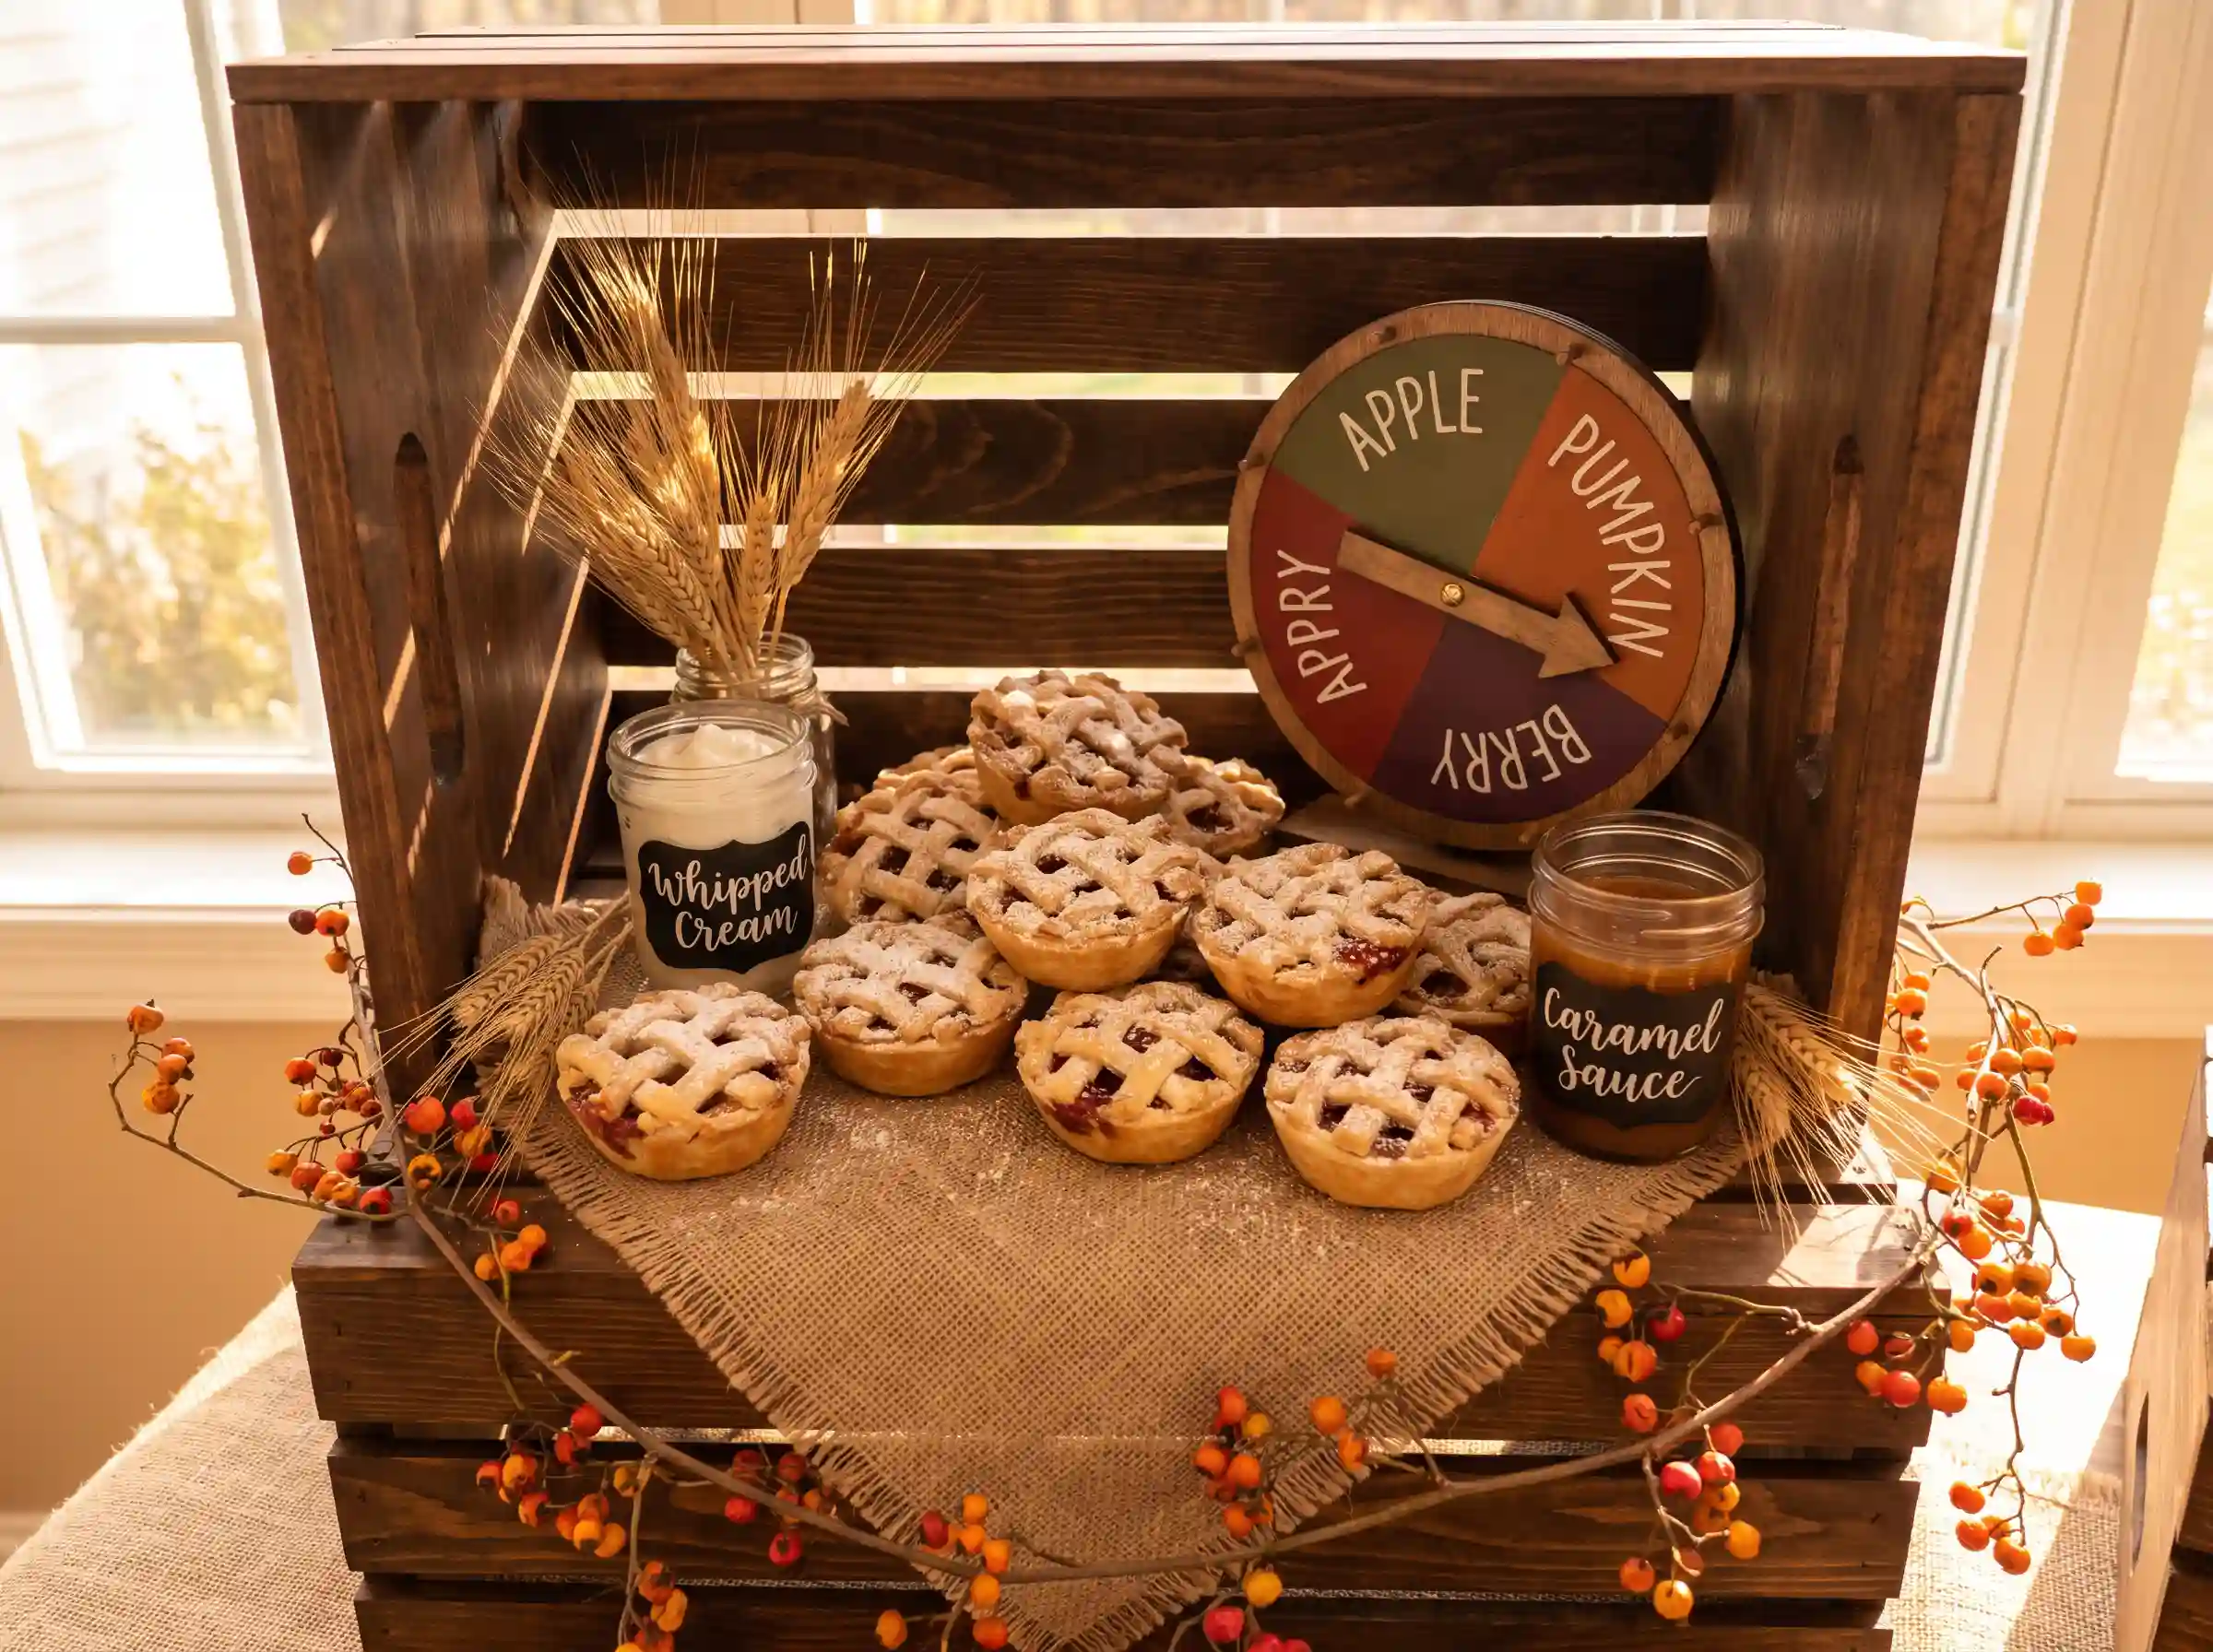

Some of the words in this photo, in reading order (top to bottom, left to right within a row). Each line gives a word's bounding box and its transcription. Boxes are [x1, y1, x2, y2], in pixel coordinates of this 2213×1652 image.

[1339, 368, 1484, 471] APPLE
[1548, 414, 1672, 657] PUMPKIN
[1277, 549, 1367, 703] APPRY
[1431, 704, 1592, 793] BERRY
[648, 833, 808, 914] Whipped
[676, 905, 798, 951] Cream
[1544, 987, 1724, 1060] Caramel
[1558, 1044, 1703, 1103] Sauce
